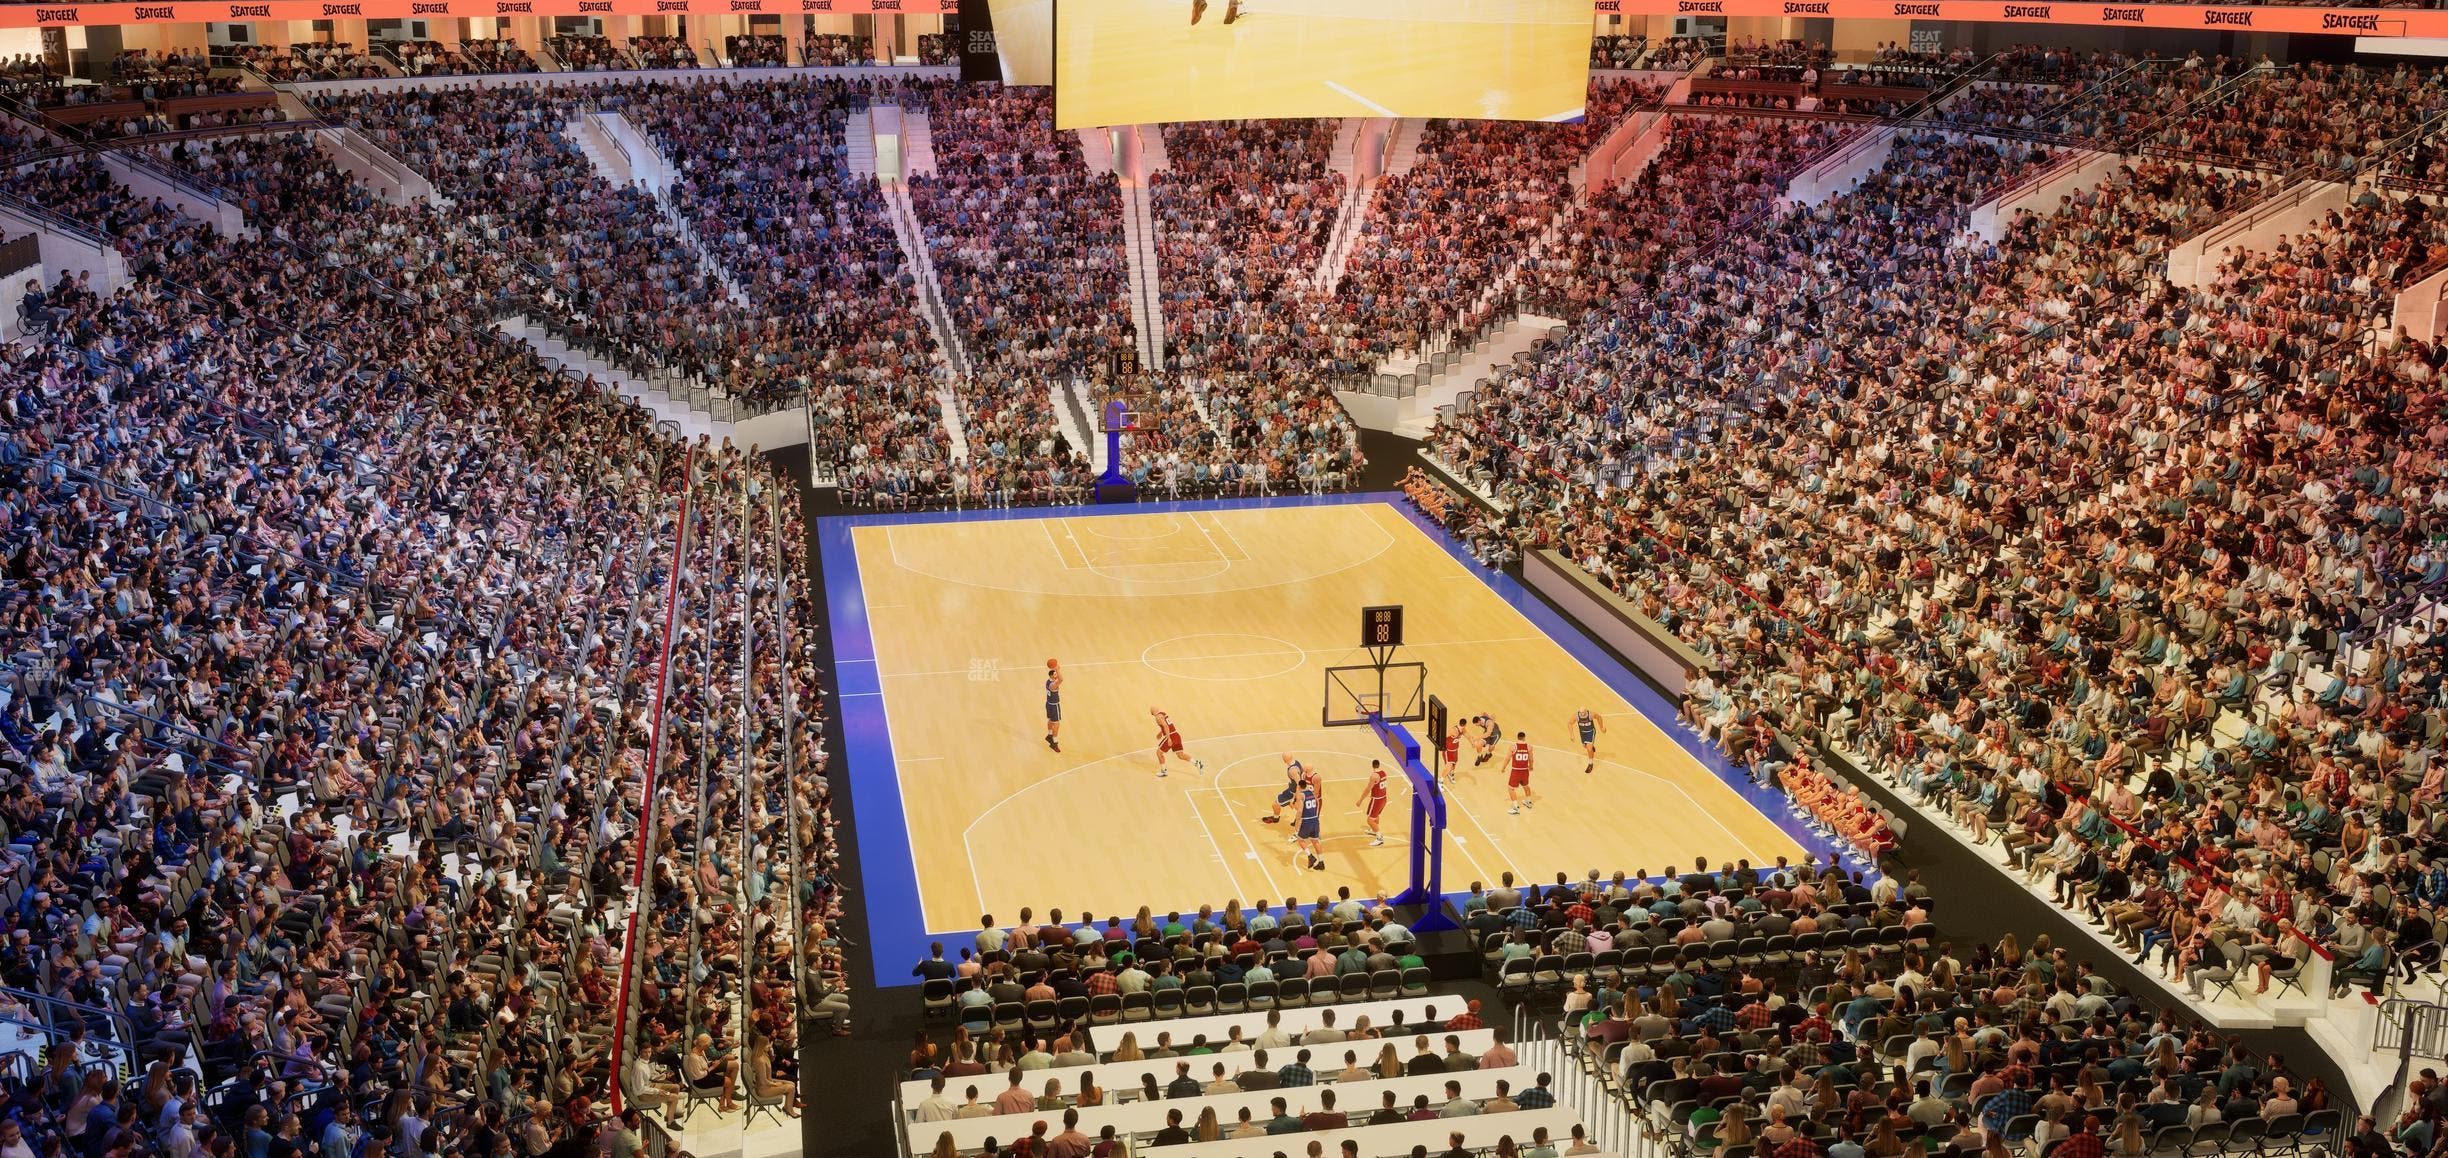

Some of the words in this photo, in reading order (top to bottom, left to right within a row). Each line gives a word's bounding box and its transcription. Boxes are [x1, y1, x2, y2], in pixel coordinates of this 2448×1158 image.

[230, 5, 271, 17] SEATGEEK
[323, 4, 361, 16] SEATGEEK
[412, 3, 449, 14] SEATGEEK
[497, 2, 532, 13] SEATGEEK
[579, 1, 613, 12] SEATGEEK
[657, 1, 688, 11] SEATGEEK
[731, 1, 761, 11] SEATGEEK
[802, 0, 832, 10] SEATGEEK
[872, 0, 901, 10] SEATGEEK
[1679, 1, 1722, 13] SEATGEEK
[1783, 2, 1829, 14] SEATGEEK
[1894, 4, 1940, 16] SEATGEEK
[36, 8, 79, 22] SEATGEEK
[135, 7, 175, 20] SEATGEEK
[2003, 5, 2051, 18] SEATGEEK
[2102, 8, 2145, 22] SEATGEEK
[2204, 10, 2253, 26] SEATGEEK
[2322, 14, 2379, 31] SEATGEEK
[1122, 362, 1133, 374] 88
[1375, 611, 1382, 622] 88
[1384, 611, 1391, 622] 88
[1377, 624, 1389, 642] 88
[1515, 753, 1529, 761] 00
[1305, 799, 1317, 809] 00
